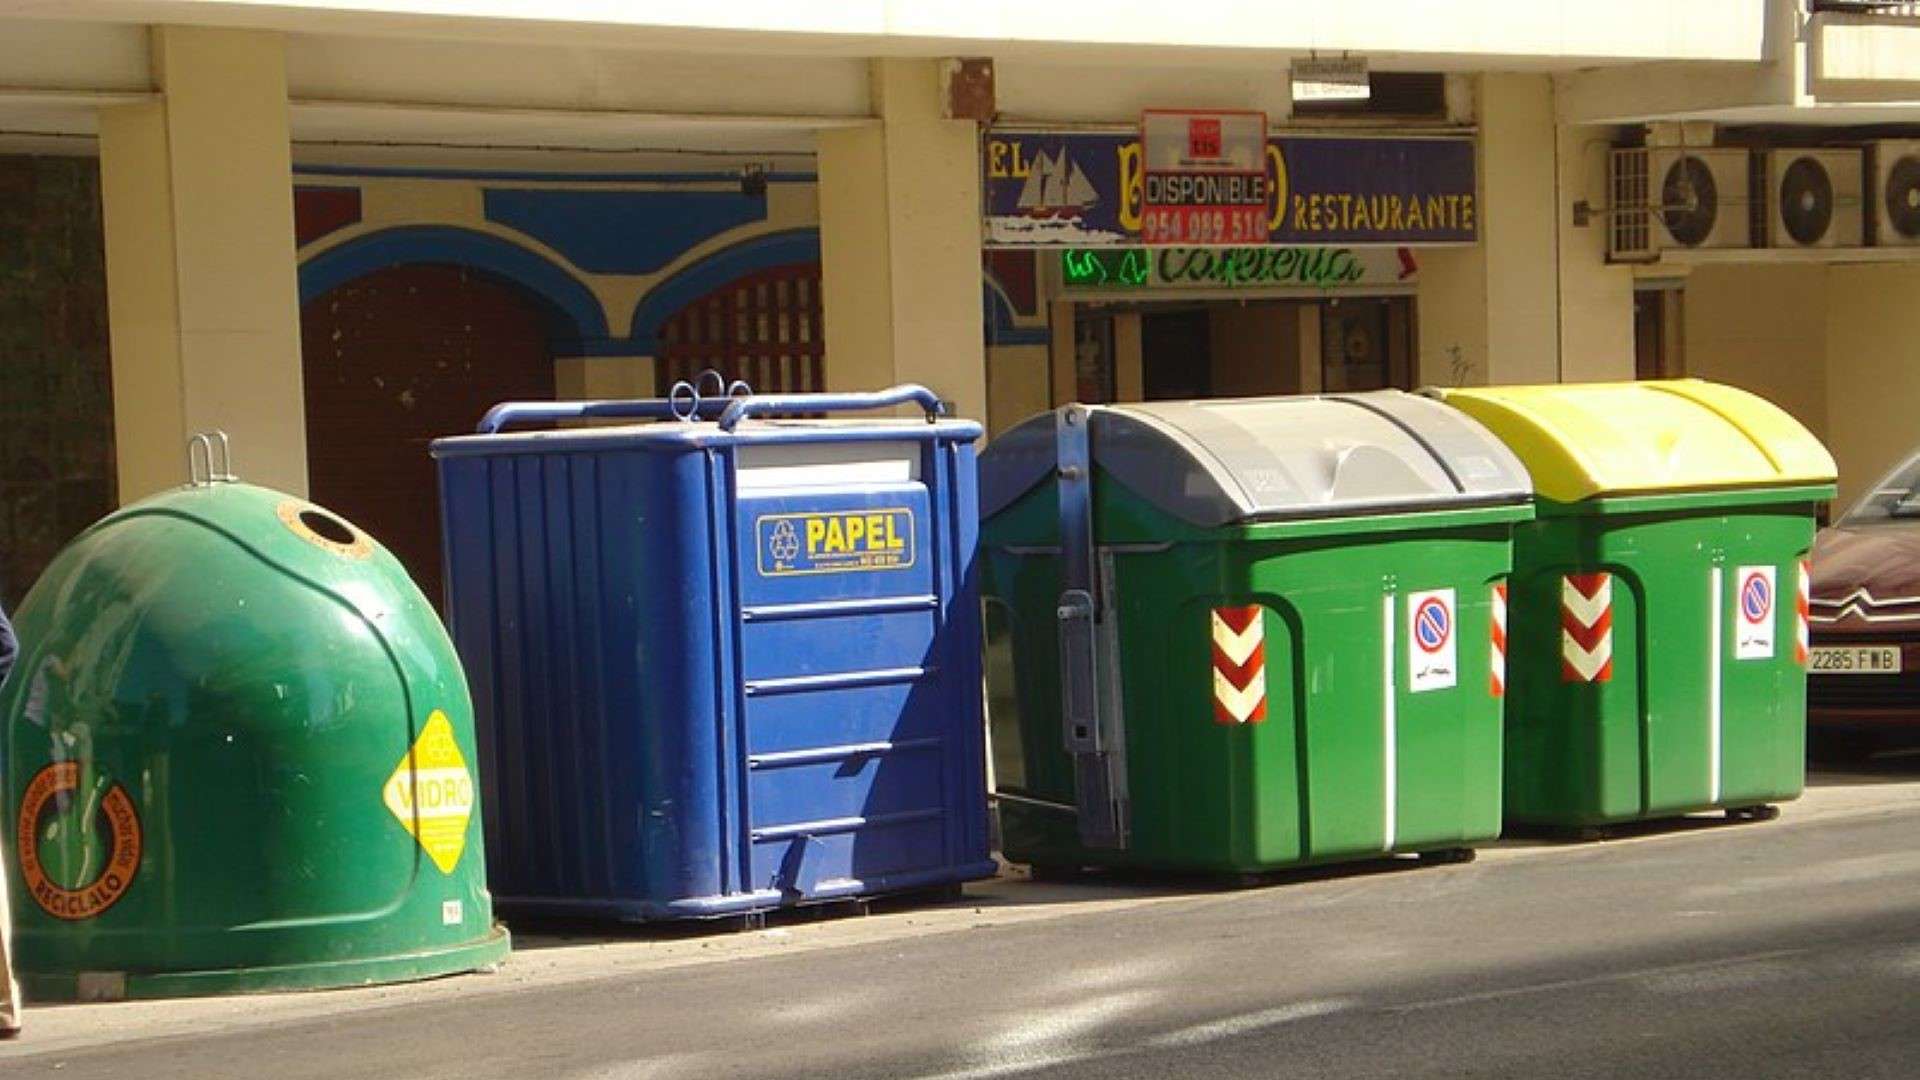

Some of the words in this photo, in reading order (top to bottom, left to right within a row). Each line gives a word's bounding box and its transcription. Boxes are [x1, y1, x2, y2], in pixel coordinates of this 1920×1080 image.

[990, 140, 1030, 178] EL
[1146, 175, 1264, 204] DISPONIBLE
[1145, 210, 1182, 241] 954
[1231, 209, 1266, 241] 510
[1294, 192, 1474, 232] RESTAURANTE
[806, 514, 904, 552] PAPEL
[1813, 649, 1853, 670] 2285
[396, 777, 471, 808] VIDRO
